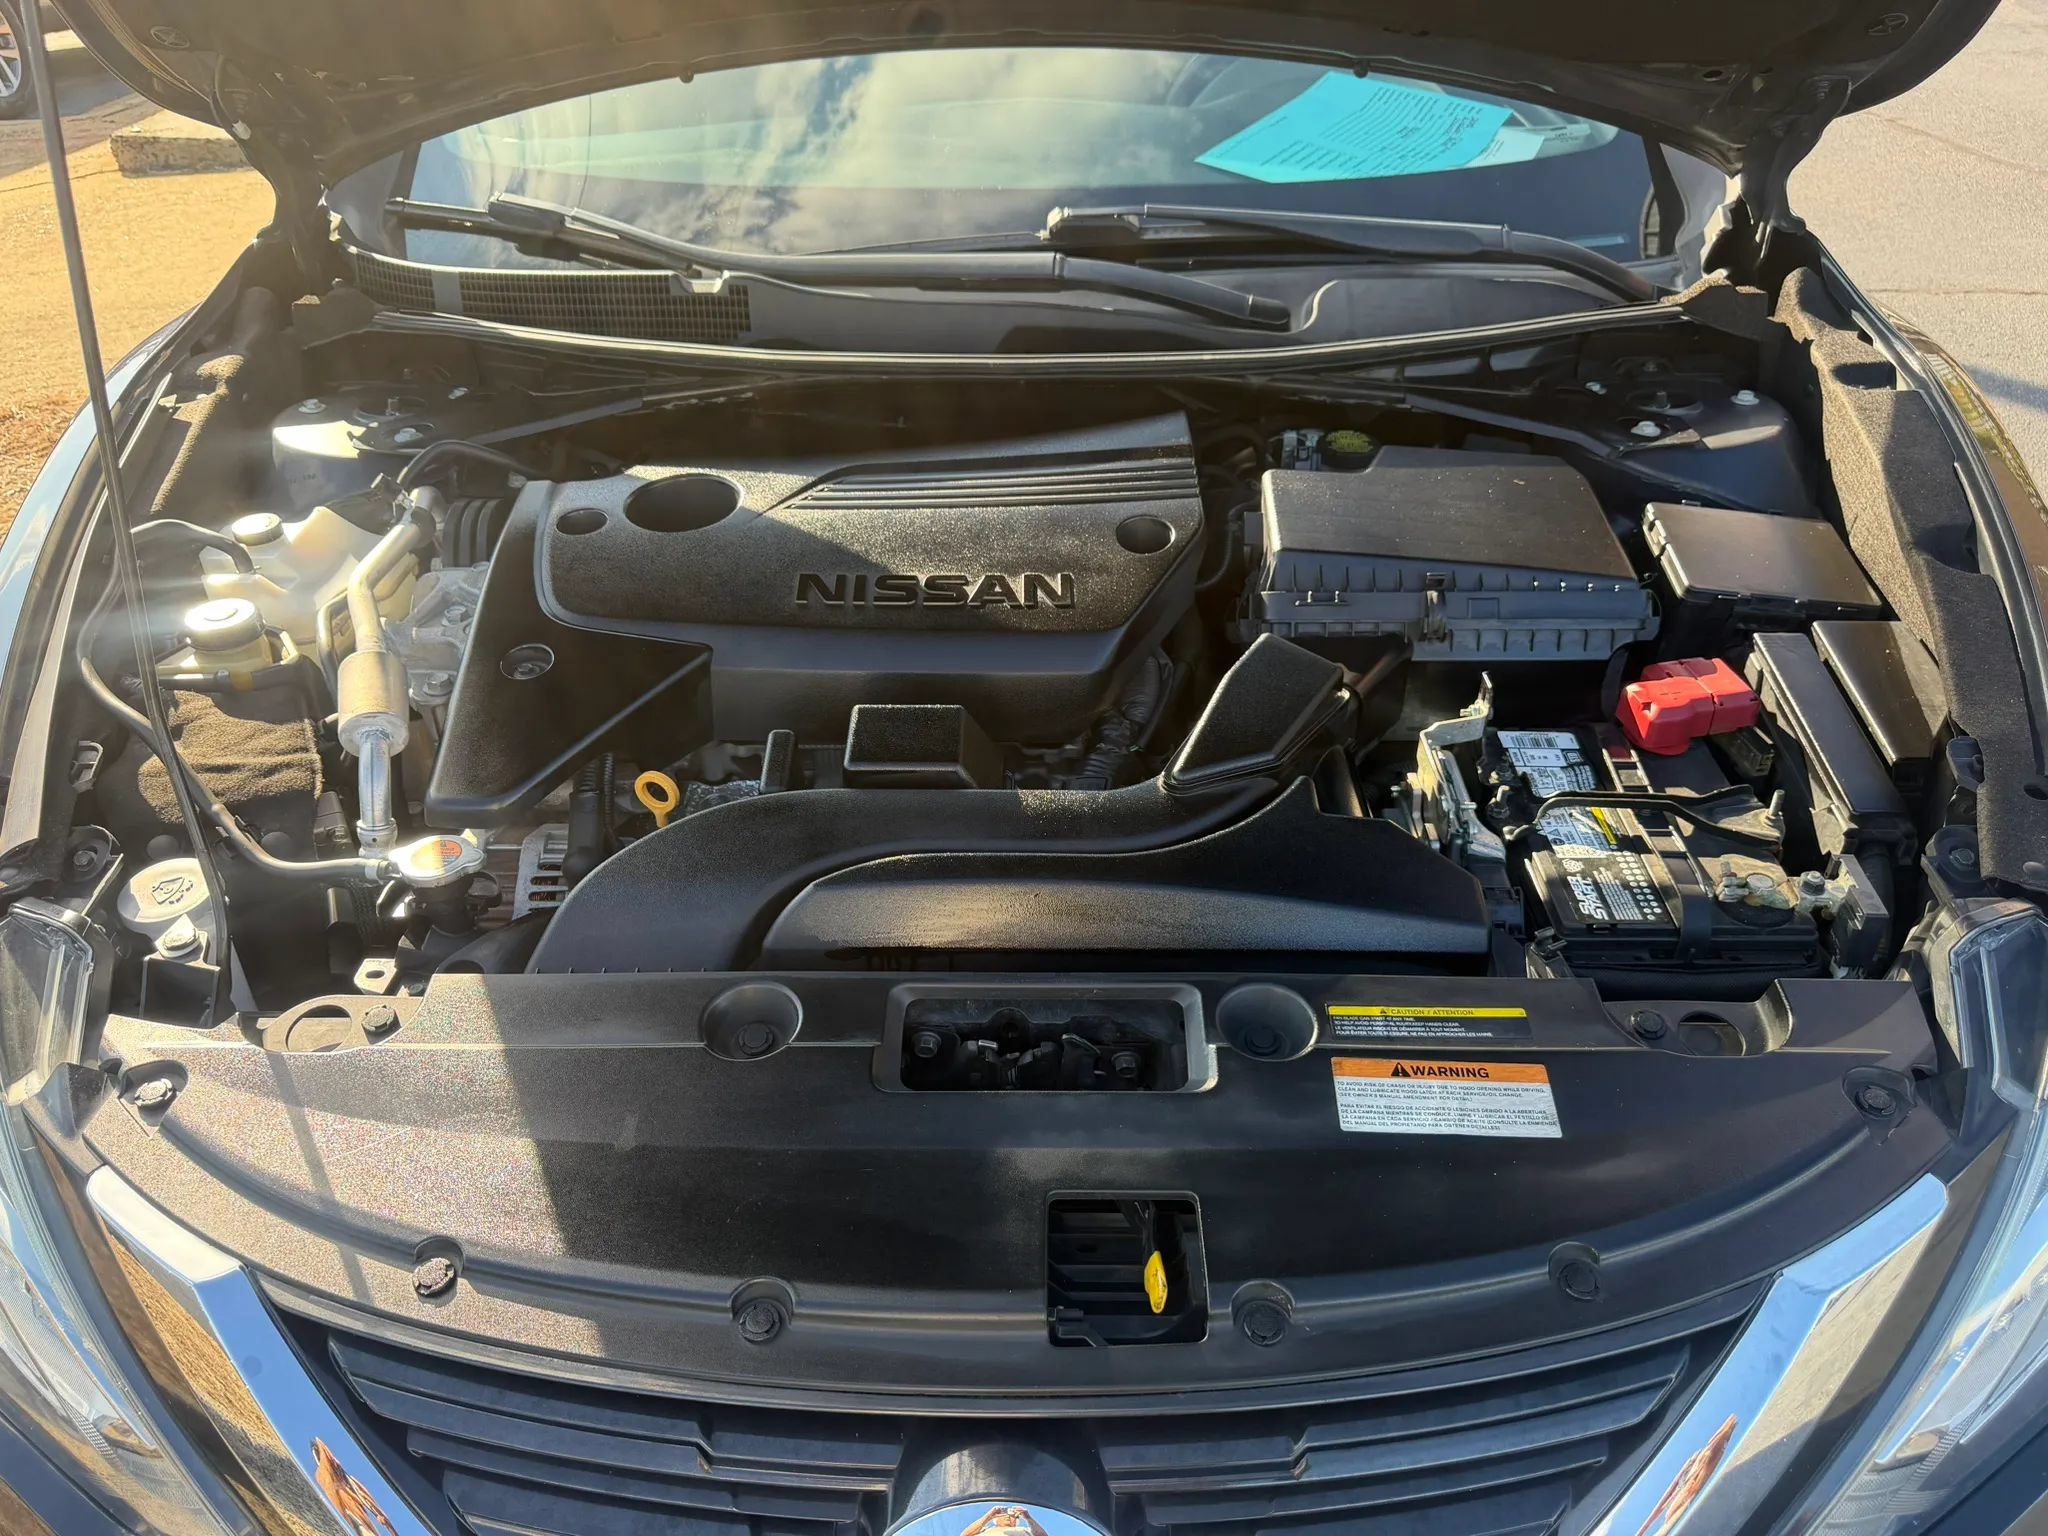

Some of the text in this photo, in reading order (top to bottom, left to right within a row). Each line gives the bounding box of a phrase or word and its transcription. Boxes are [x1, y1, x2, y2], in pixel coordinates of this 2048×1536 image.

[795, 572, 1076, 609] NISSAN
[1566, 875, 1591, 915] SUPER
[1410, 1065, 1489, 1079] WARNING
